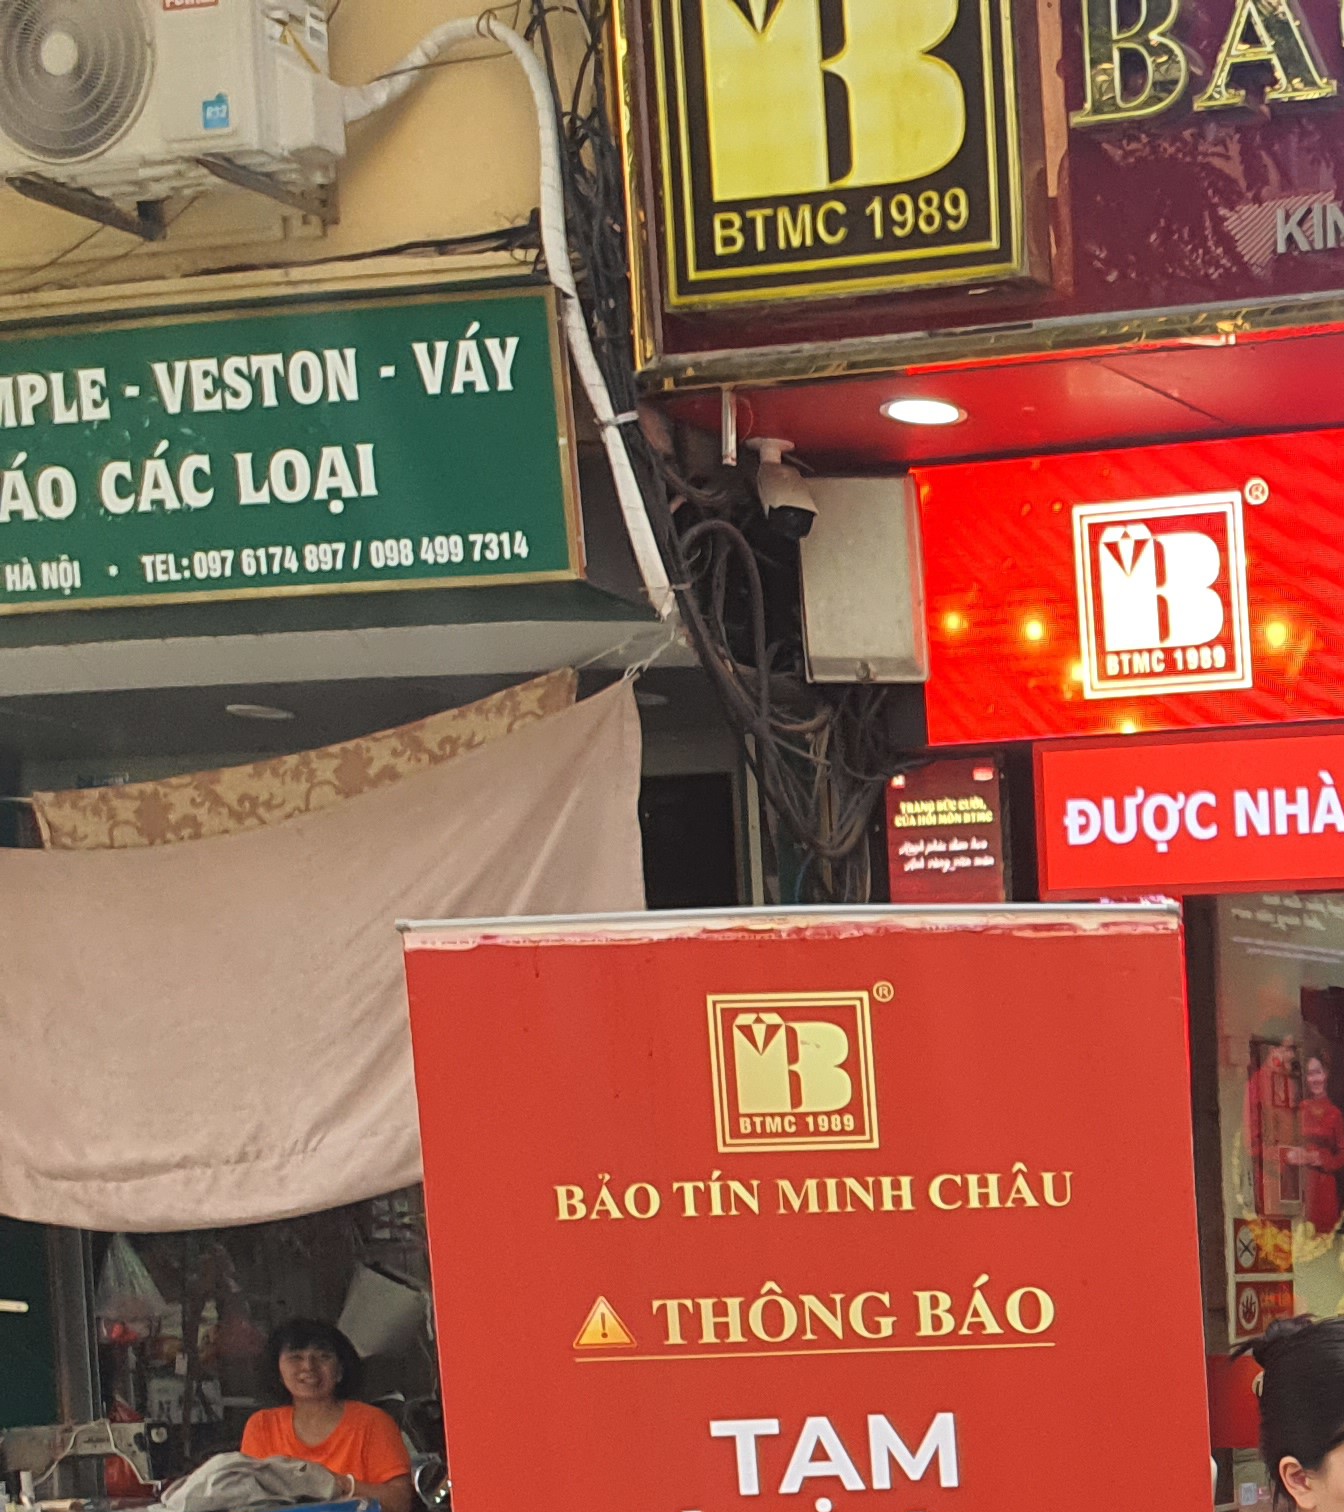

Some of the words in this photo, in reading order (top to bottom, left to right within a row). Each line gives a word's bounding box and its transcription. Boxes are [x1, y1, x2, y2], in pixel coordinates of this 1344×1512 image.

[711, 203, 848, 257] BTMC
[865, 188, 970, 241] 1989
[153, 347, 360, 416] VESTON
[412, 322, 520, 395] VÁY
[0, 451, 77, 522] ÁO
[101, 439, 215, 514] CÁC
[237, 443, 379, 516] LOẠI
[4, 557, 37, 592] HÀ
[41, 554, 82, 595] NỘI
[241, 546, 299, 577] 6174
[303, 541, 347, 573] 897
[369, 538, 415, 569] 098
[420, 535, 465, 565] 499
[468, 530, 529, 561] 7314
[1106, 650, 1166, 676] BTMC
[1174, 645, 1226, 671] 1989
[1064, 789, 1218, 852] ĐƯỢC
[739, 1114, 798, 1135] BTMC
[806, 1111, 856, 1134] 1989
[554, 1172, 660, 1222] BẢO
[673, 1169, 761, 1218] TÍN
[776, 1174, 914, 1214] MINH
[928, 1162, 1075, 1210] CHÂU
[652, 1281, 898, 1347] THÔNG
[914, 1273, 1057, 1338] BÁO
